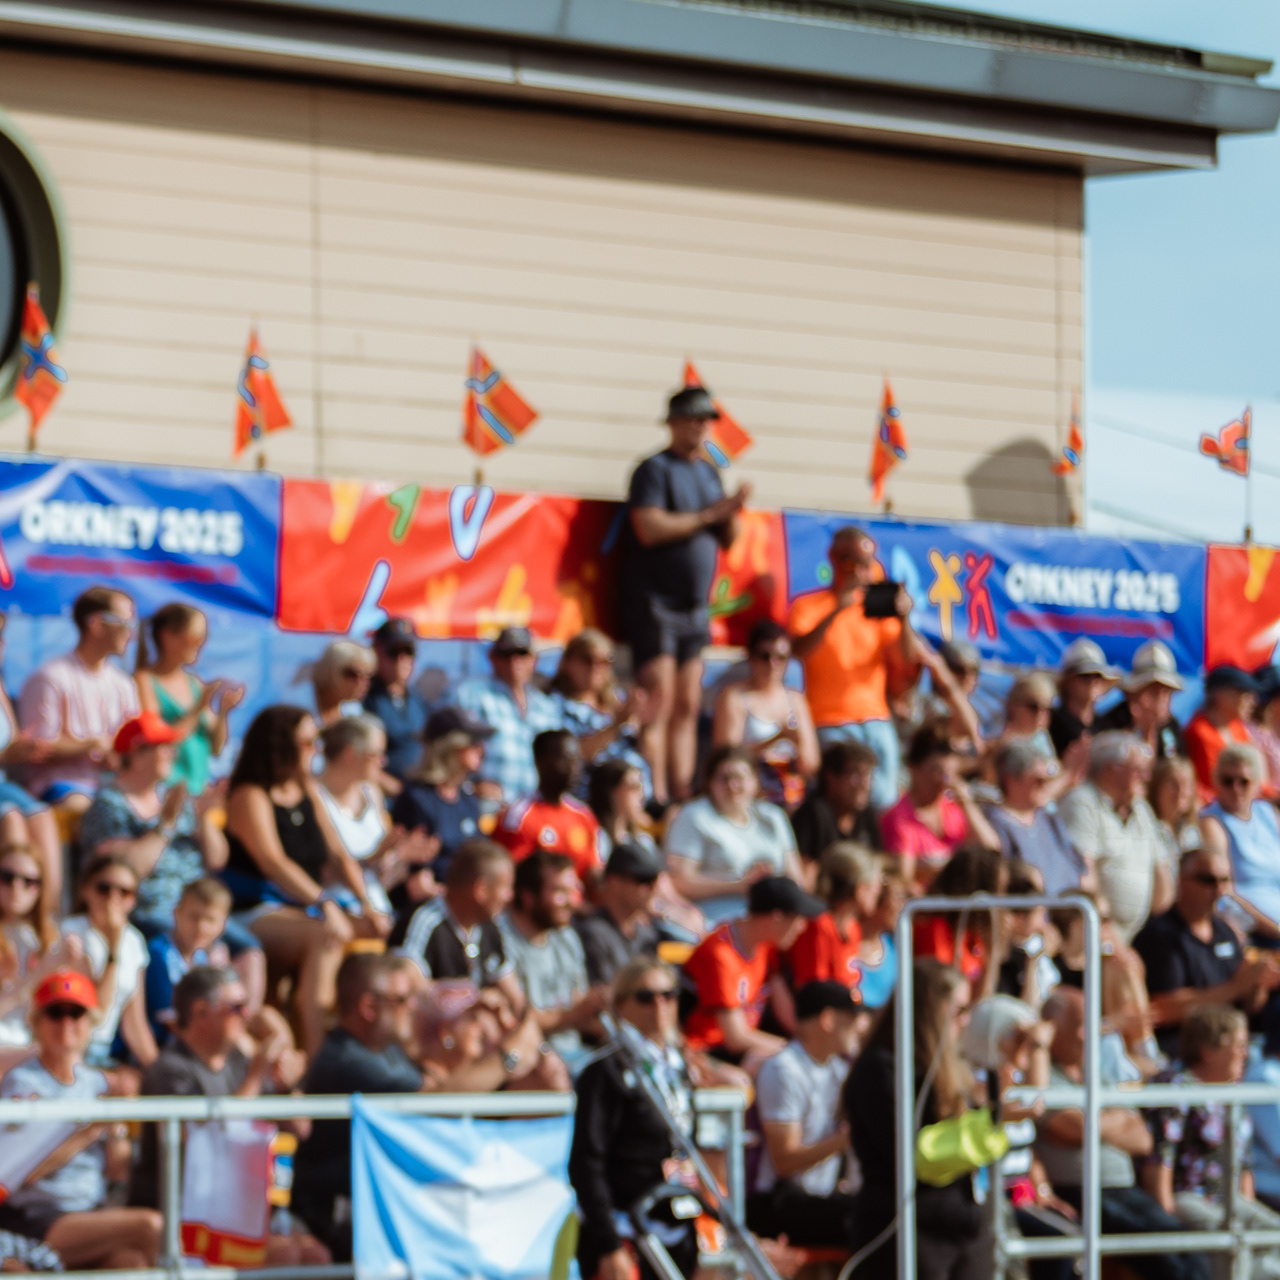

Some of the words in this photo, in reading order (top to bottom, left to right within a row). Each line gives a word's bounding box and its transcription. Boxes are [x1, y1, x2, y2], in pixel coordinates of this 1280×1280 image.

[20, 499, 159, 551] ORKNEY
[159, 506, 244, 557] 2025
[1005, 562, 1114, 609] ORKNEY
[1114, 568, 1180, 614] 2025
